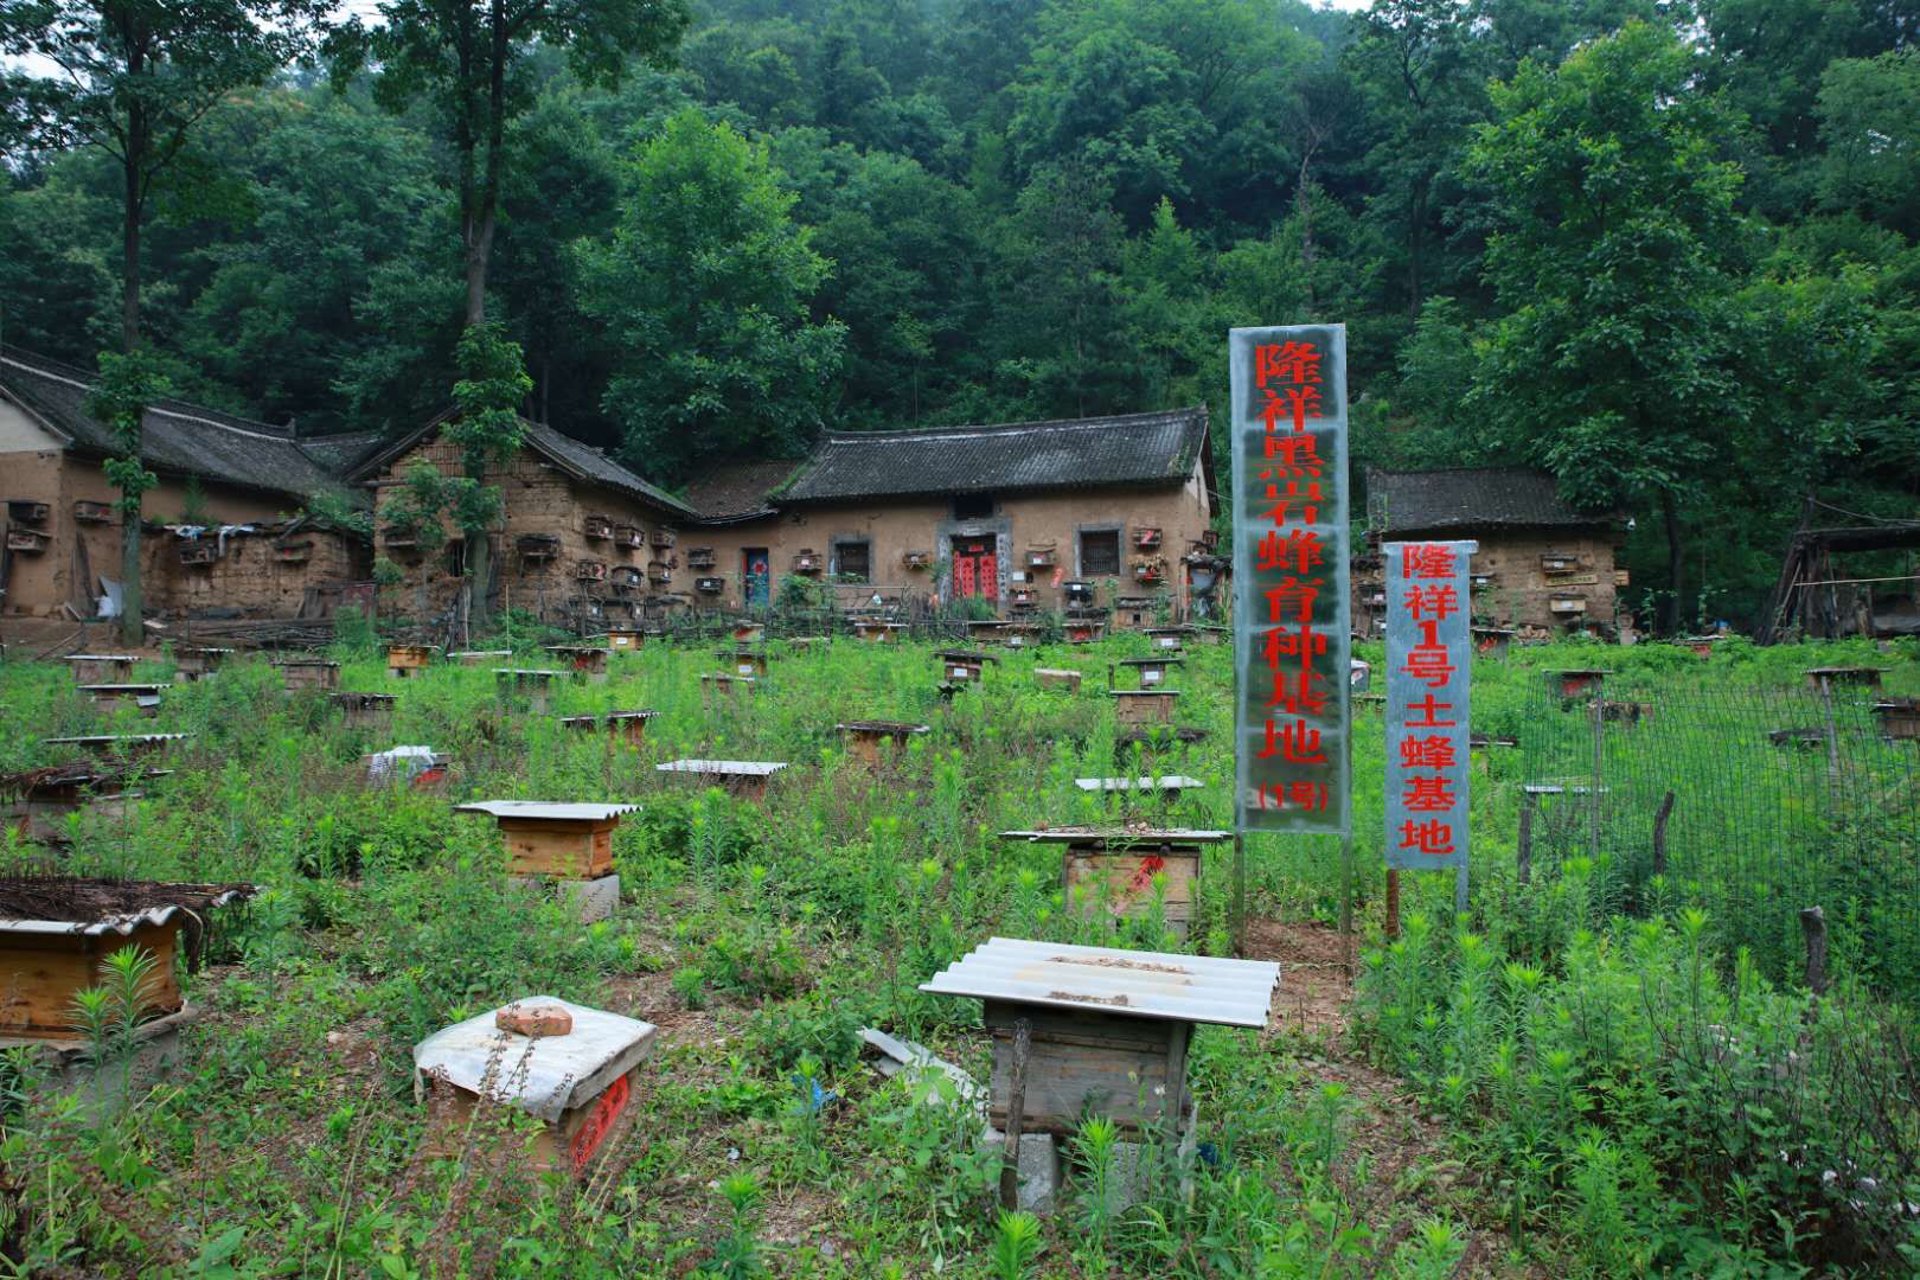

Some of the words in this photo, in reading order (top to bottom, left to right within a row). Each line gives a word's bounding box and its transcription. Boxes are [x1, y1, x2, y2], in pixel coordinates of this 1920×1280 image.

[1254, 340, 1329, 764] 隆祥黑岩蜂育种基地
[1399, 544, 1458, 854] 隆祥1号土蜂基地
[1258, 780, 1329, 813] (1号)
